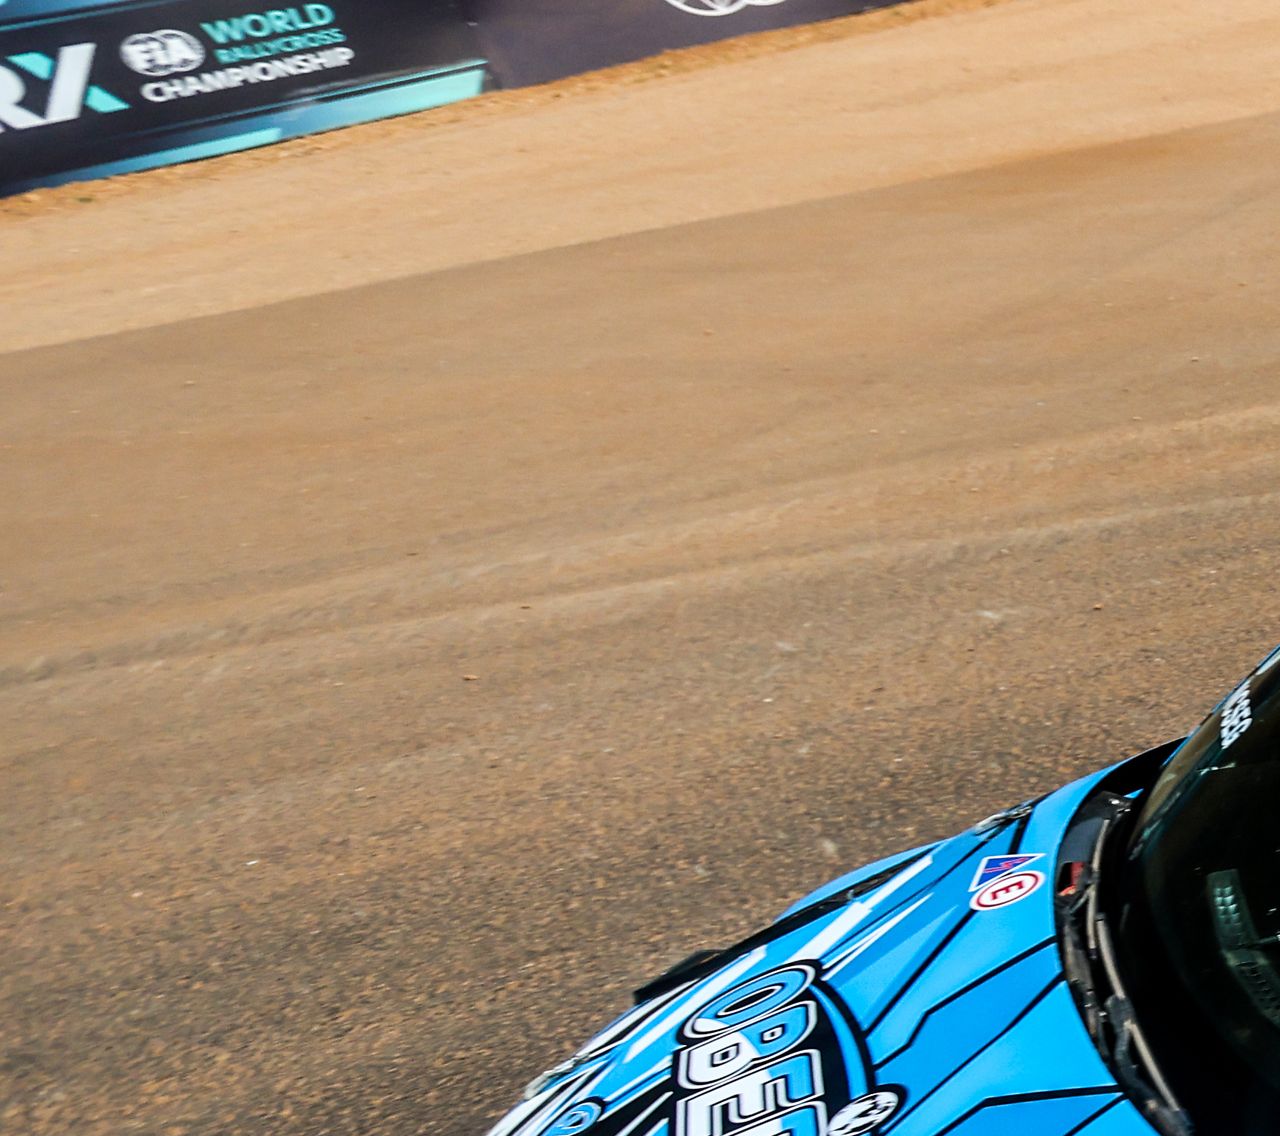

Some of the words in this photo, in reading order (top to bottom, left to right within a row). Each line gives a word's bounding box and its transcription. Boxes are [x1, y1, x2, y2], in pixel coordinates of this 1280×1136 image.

[200, 4, 335, 43] WORLD
[215, 28, 347, 63] RALLYCROSS
[140, 47, 355, 102] CHAMPIONSHIP
